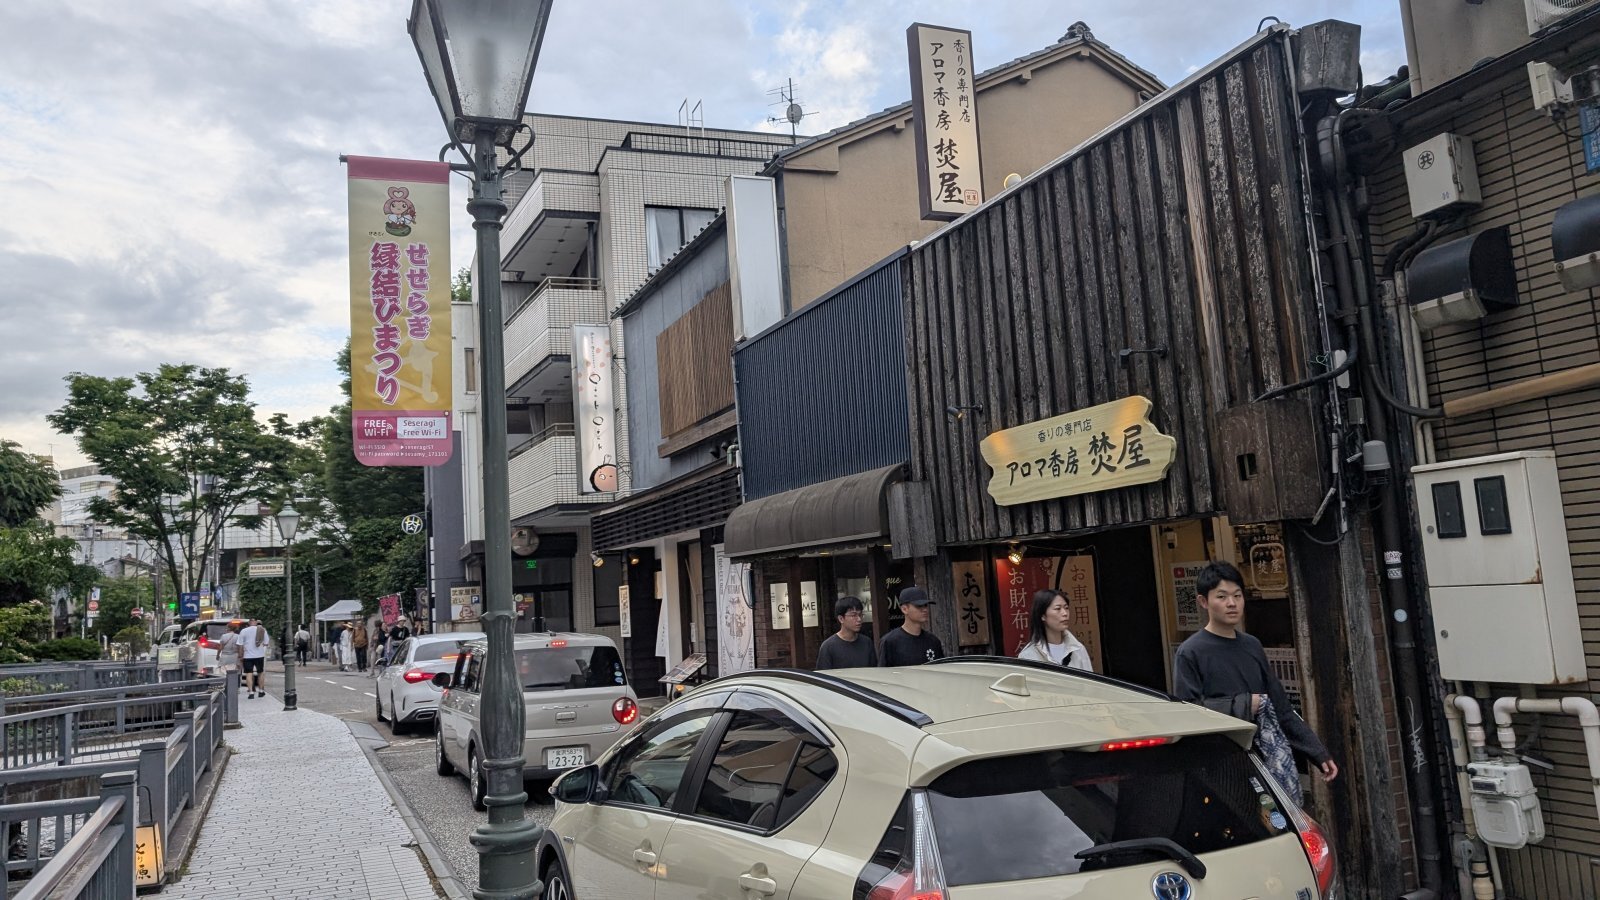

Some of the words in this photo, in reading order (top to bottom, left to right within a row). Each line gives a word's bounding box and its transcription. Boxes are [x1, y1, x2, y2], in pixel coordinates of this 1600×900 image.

[930, 42, 951, 131] アロマ香房
[953, 39, 970, 123] 香りの専門店
[933, 138, 964, 205] 焚屋
[371, 242, 402, 405] 縁結びまつり
[406, 243, 431, 341] せせらぎ
[364, 420, 387, 428] FREE
[364, 428, 389, 436] Wi-Fi
[403, 420, 436, 428] Seseragi
[1006, 446, 1079, 486] アロマ香房
[1088, 424, 1150, 476] 焚屋
[1037, 418, 1093, 443] 香りの専門店
[962, 571, 985, 635] お香
[555, 754, 584, 767] 23-22
